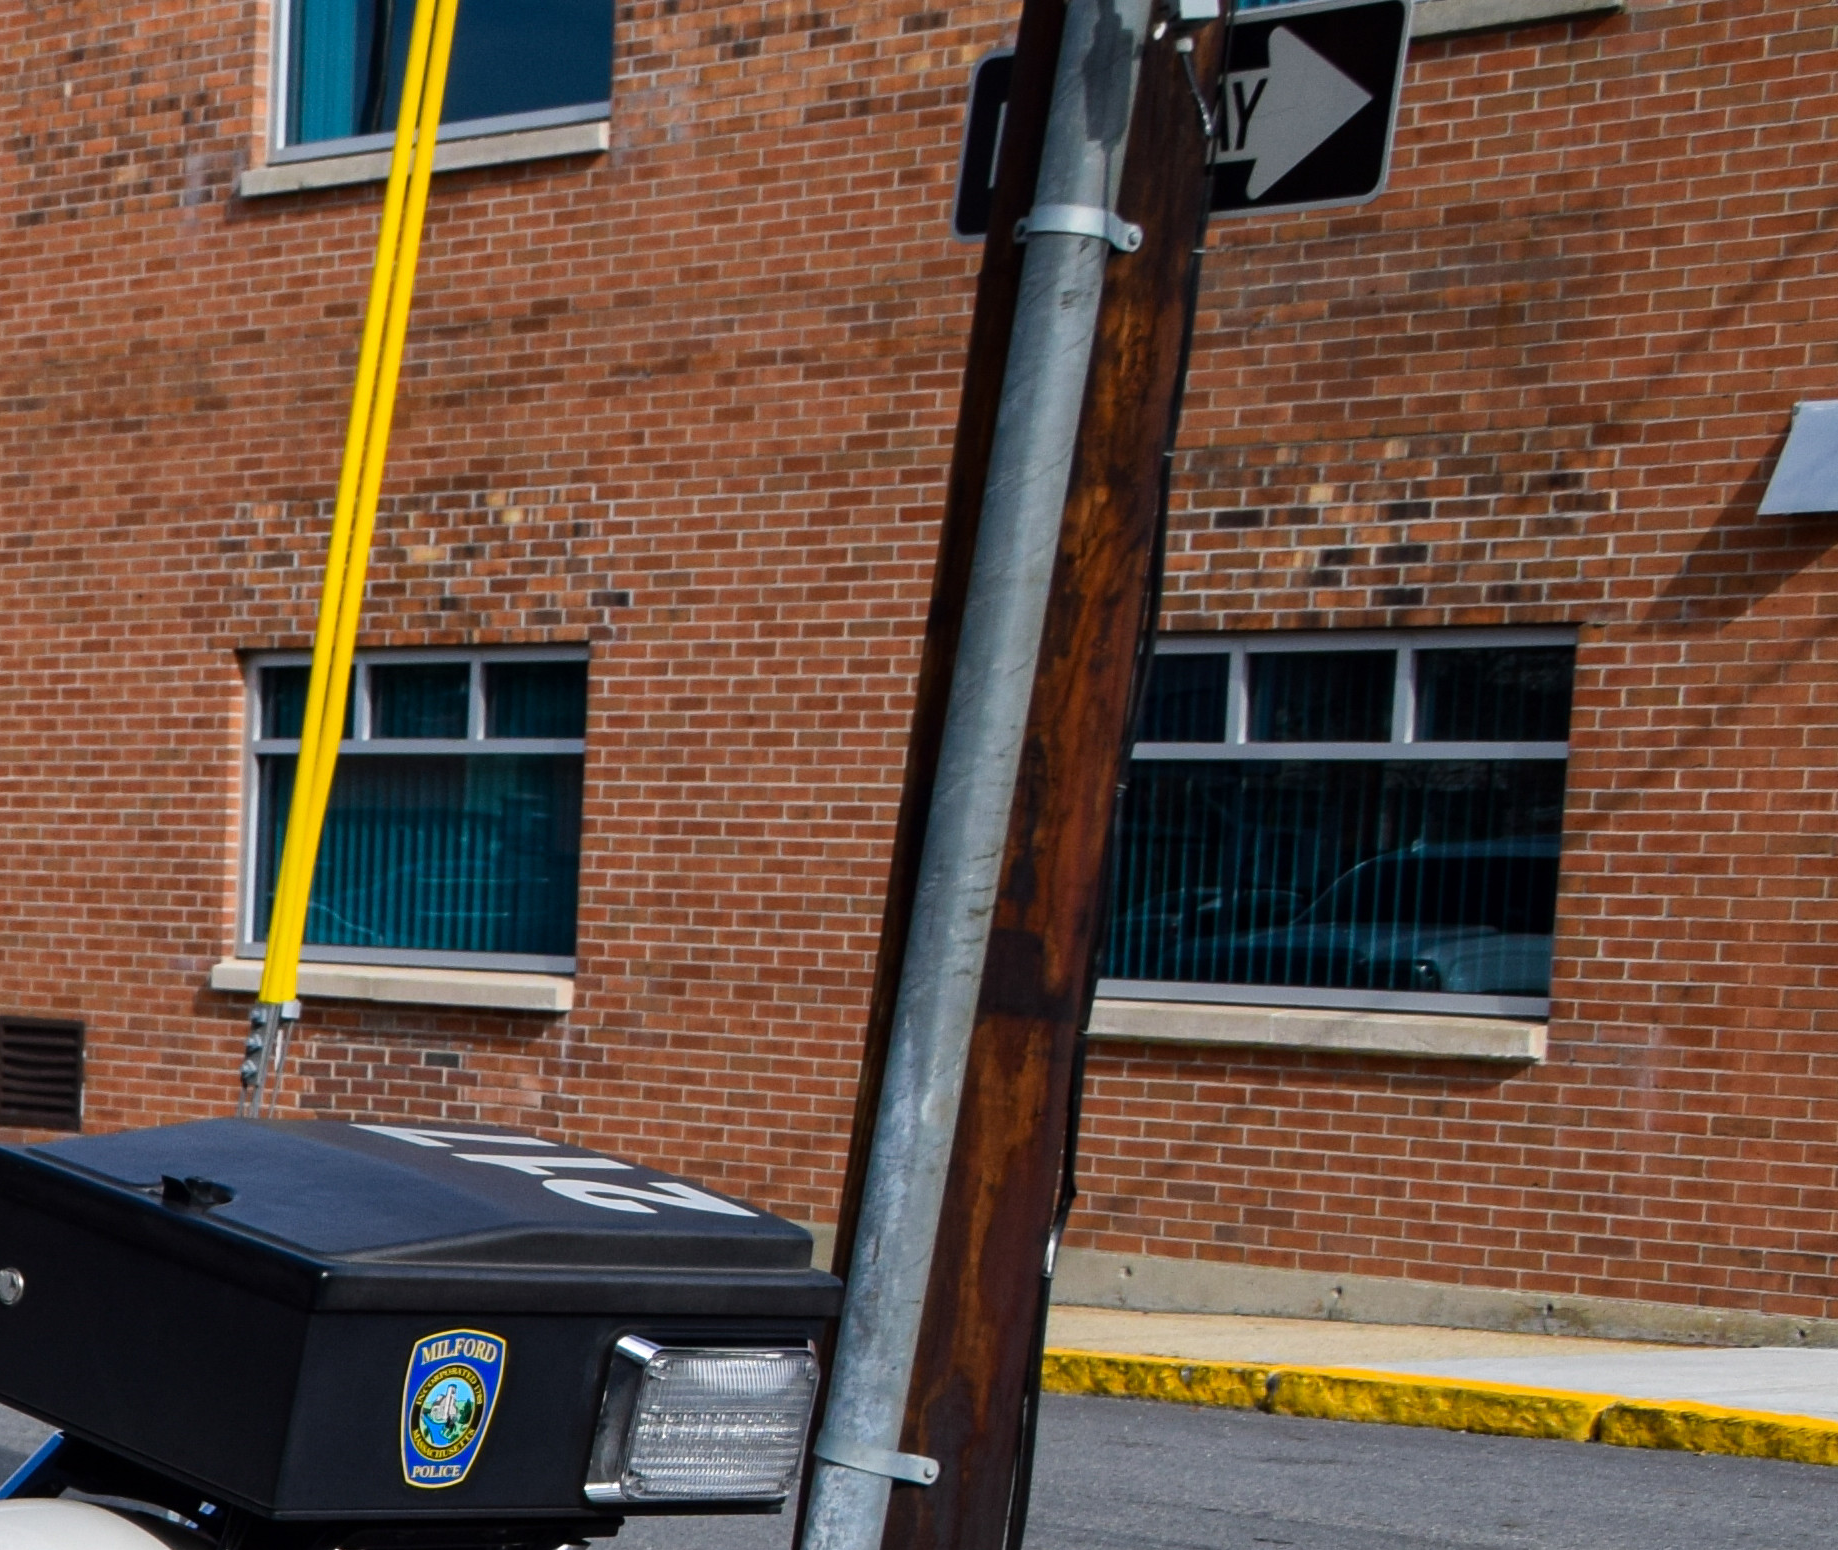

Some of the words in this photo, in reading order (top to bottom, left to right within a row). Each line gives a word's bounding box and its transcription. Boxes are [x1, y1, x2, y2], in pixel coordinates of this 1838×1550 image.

[1210, 76, 1269, 153] AY
[349, 1123, 759, 1217] 217
[421, 1337, 498, 1366] MILFORD
[411, 1464, 462, 1479] POLICE
